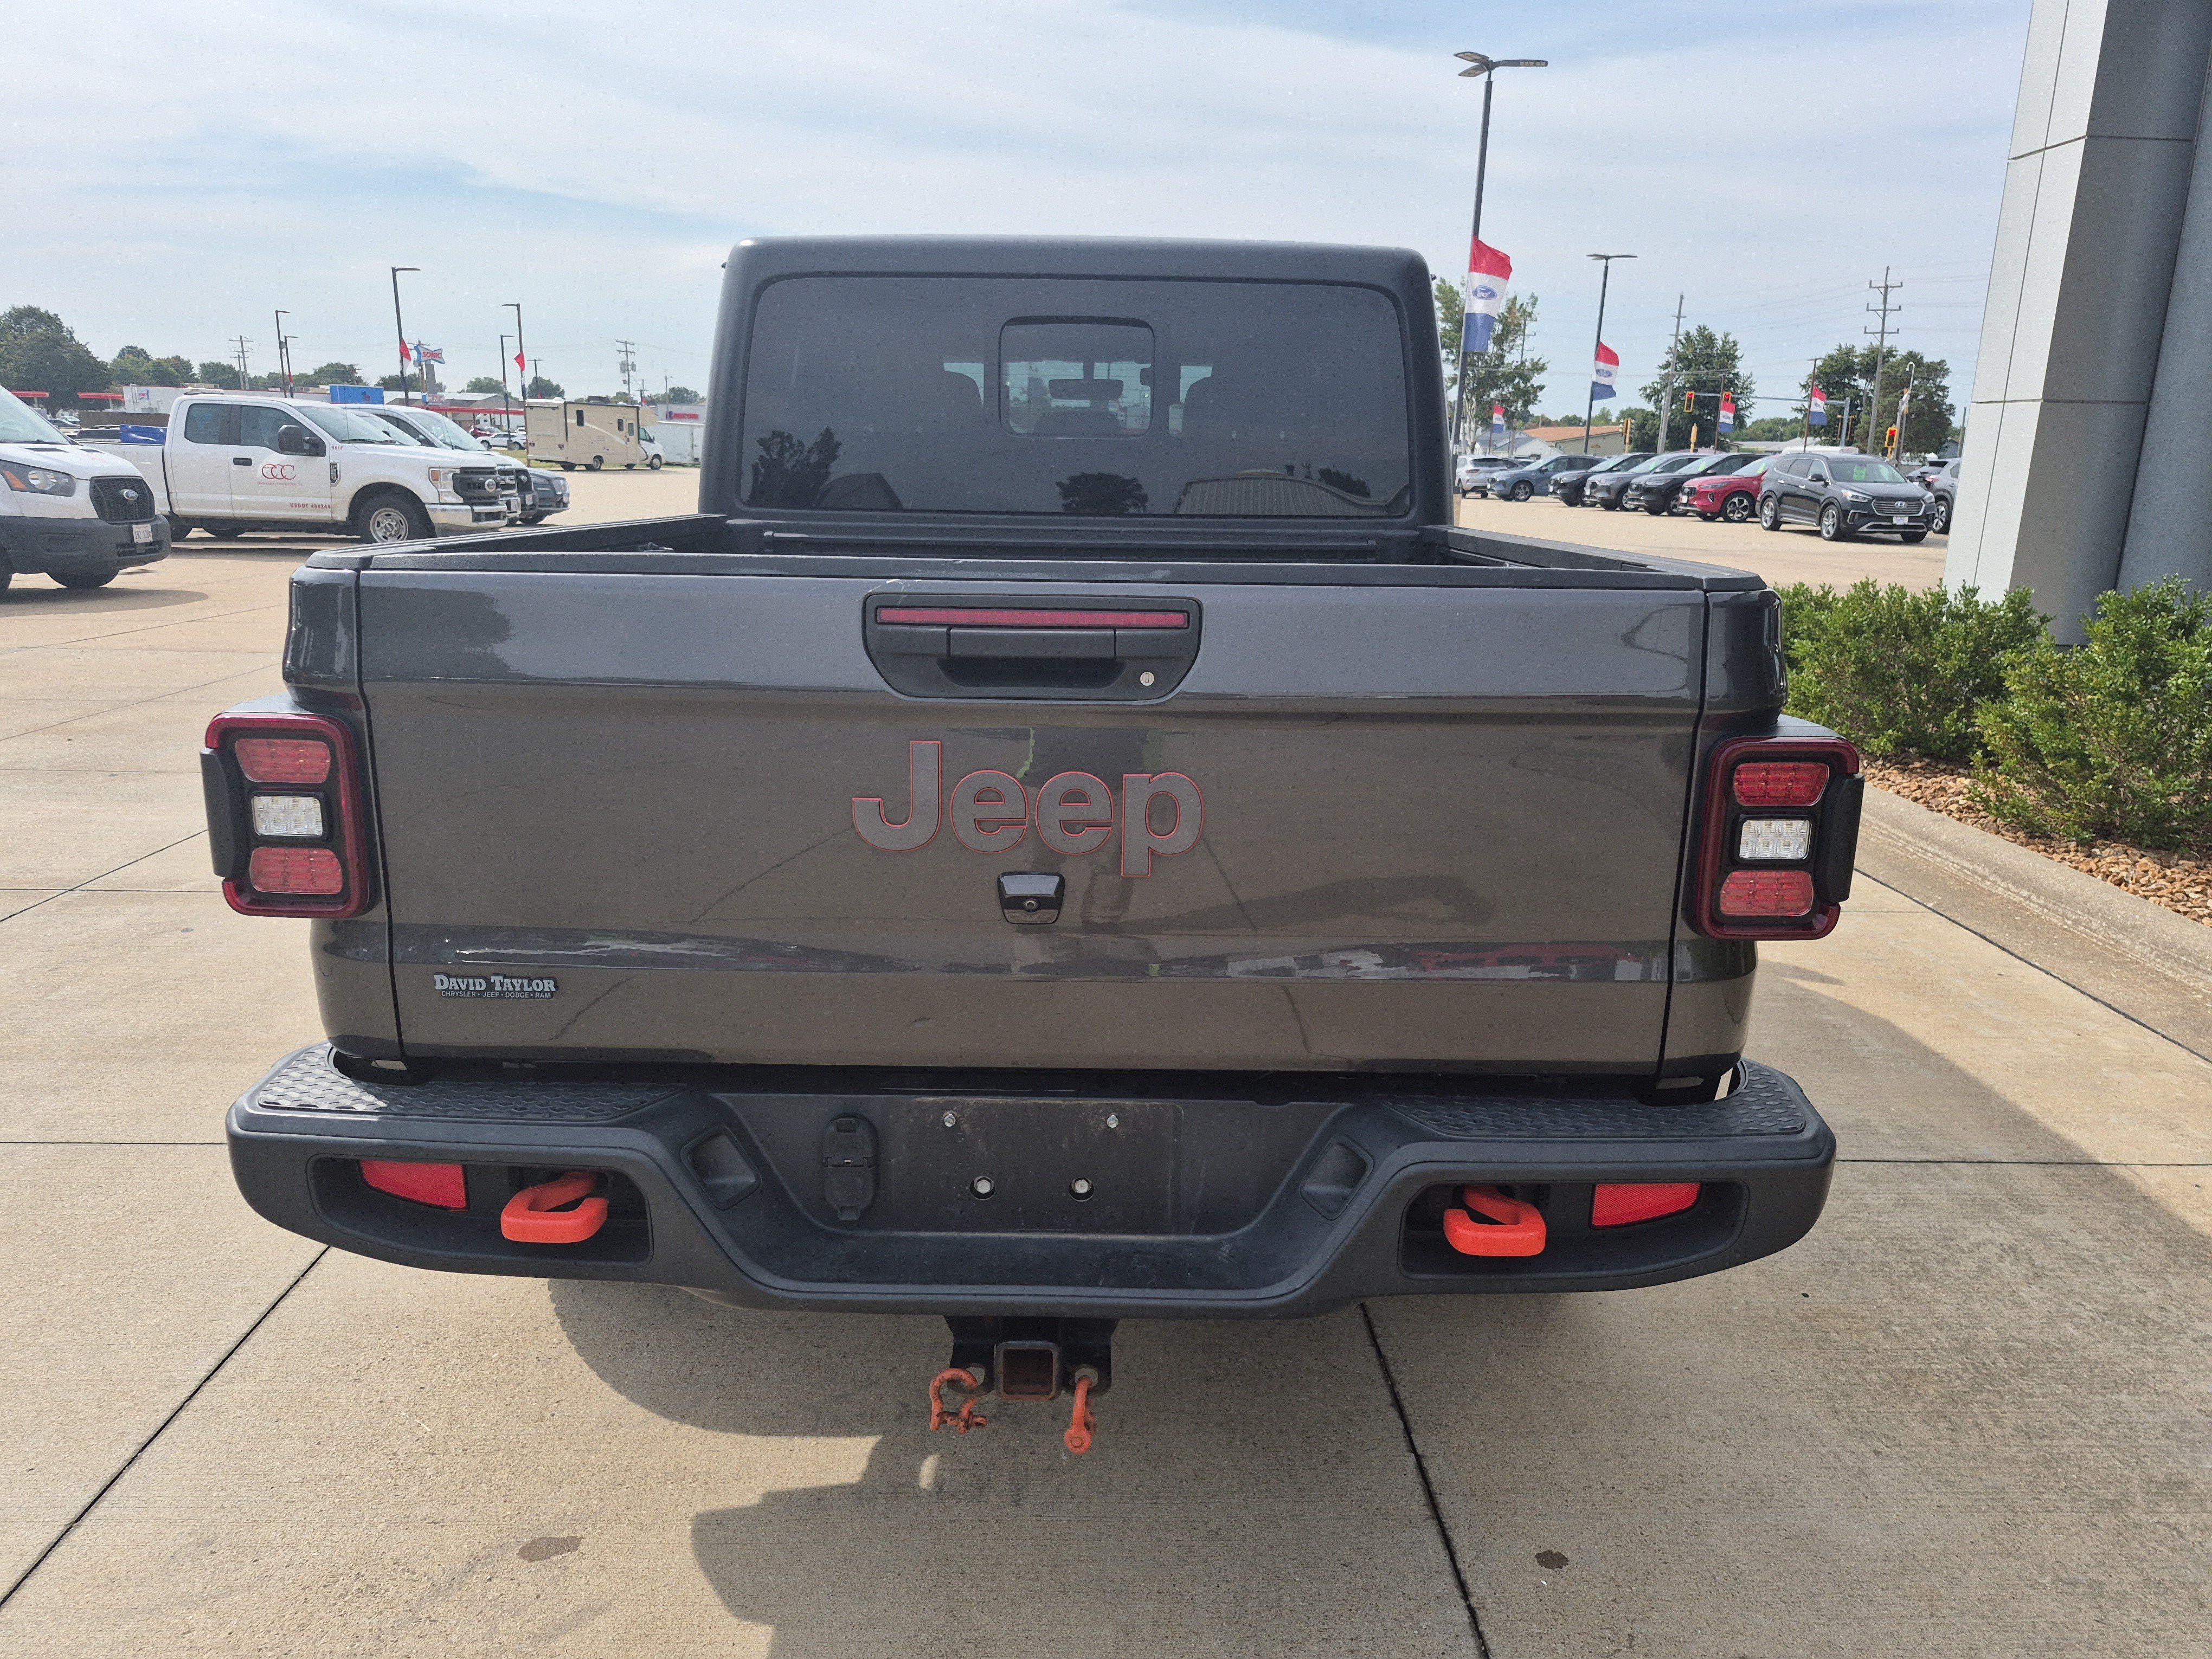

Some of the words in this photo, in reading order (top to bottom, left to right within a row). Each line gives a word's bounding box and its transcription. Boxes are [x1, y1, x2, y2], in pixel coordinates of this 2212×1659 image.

[852, 740, 1205, 877] Jeep
[434, 974, 486, 991] DAVID
[490, 976, 556, 992] TAYLOR
